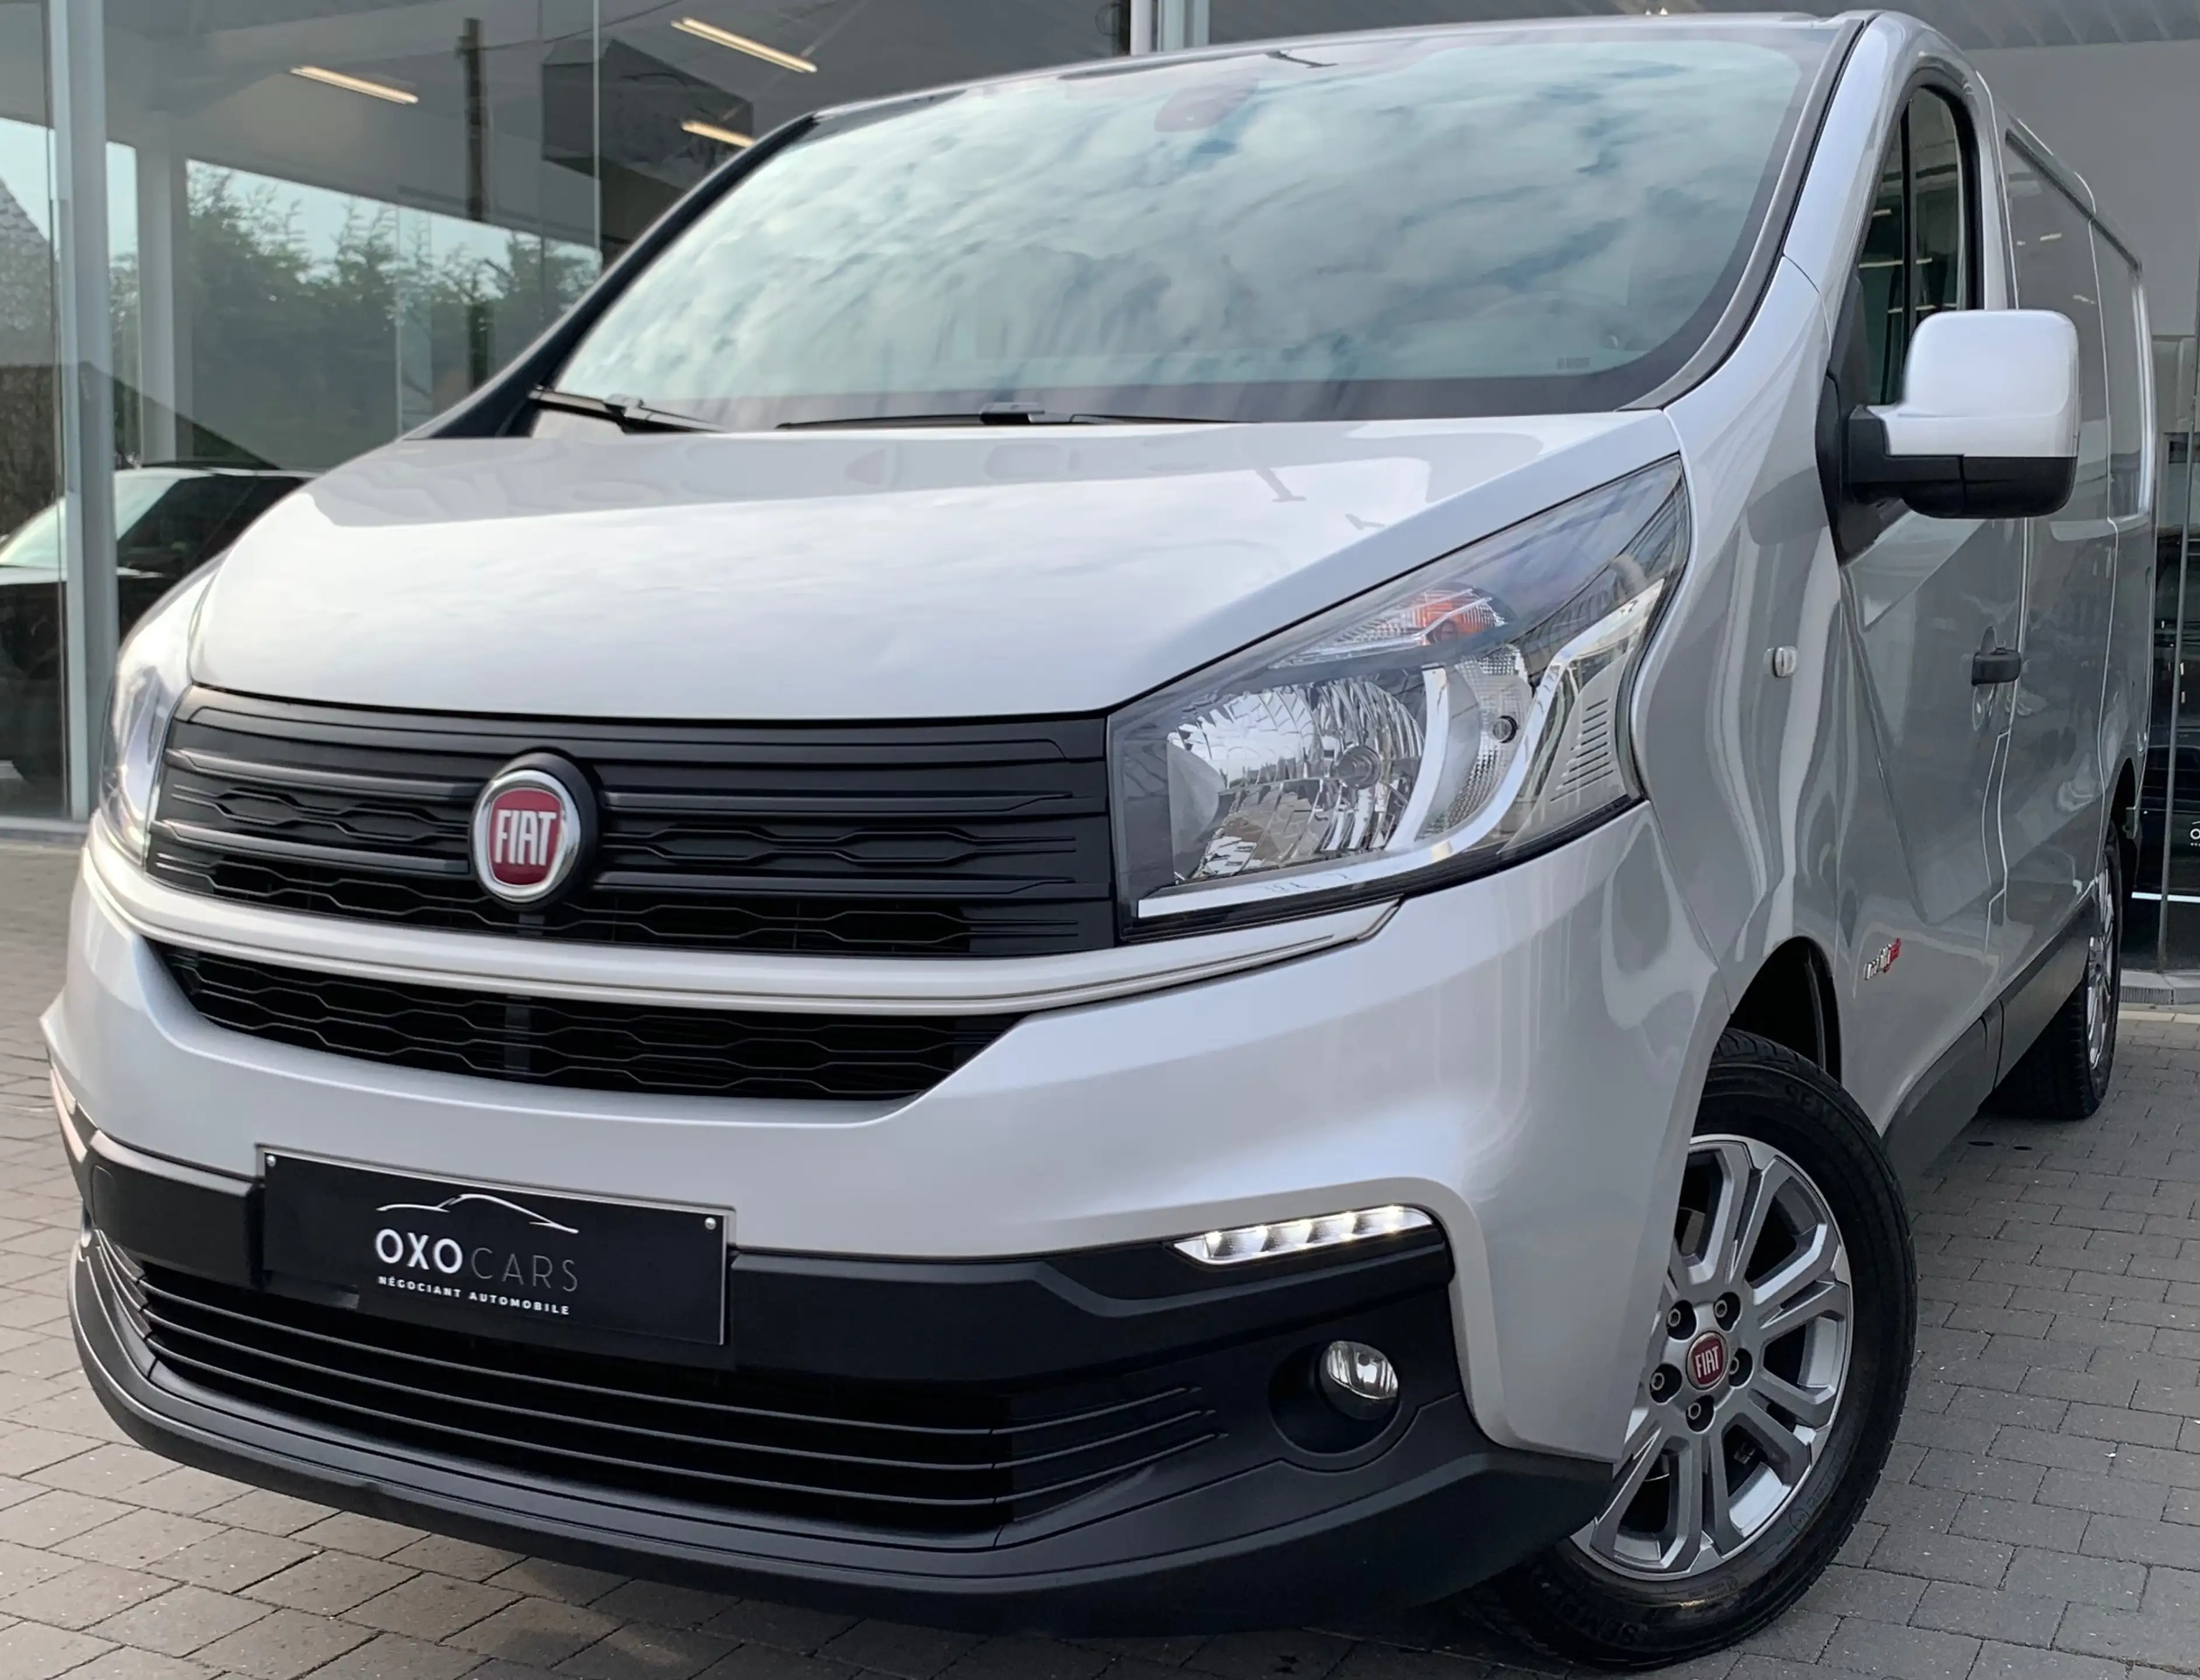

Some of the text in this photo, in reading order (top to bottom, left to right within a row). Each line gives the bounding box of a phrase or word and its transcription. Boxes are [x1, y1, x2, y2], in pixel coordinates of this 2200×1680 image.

[495, 808, 557, 866] FIAT
[378, 1275, 570, 1315] NÉGOCIANT AUTOMOBILE
[1694, 1345, 1719, 1379] FIAT
